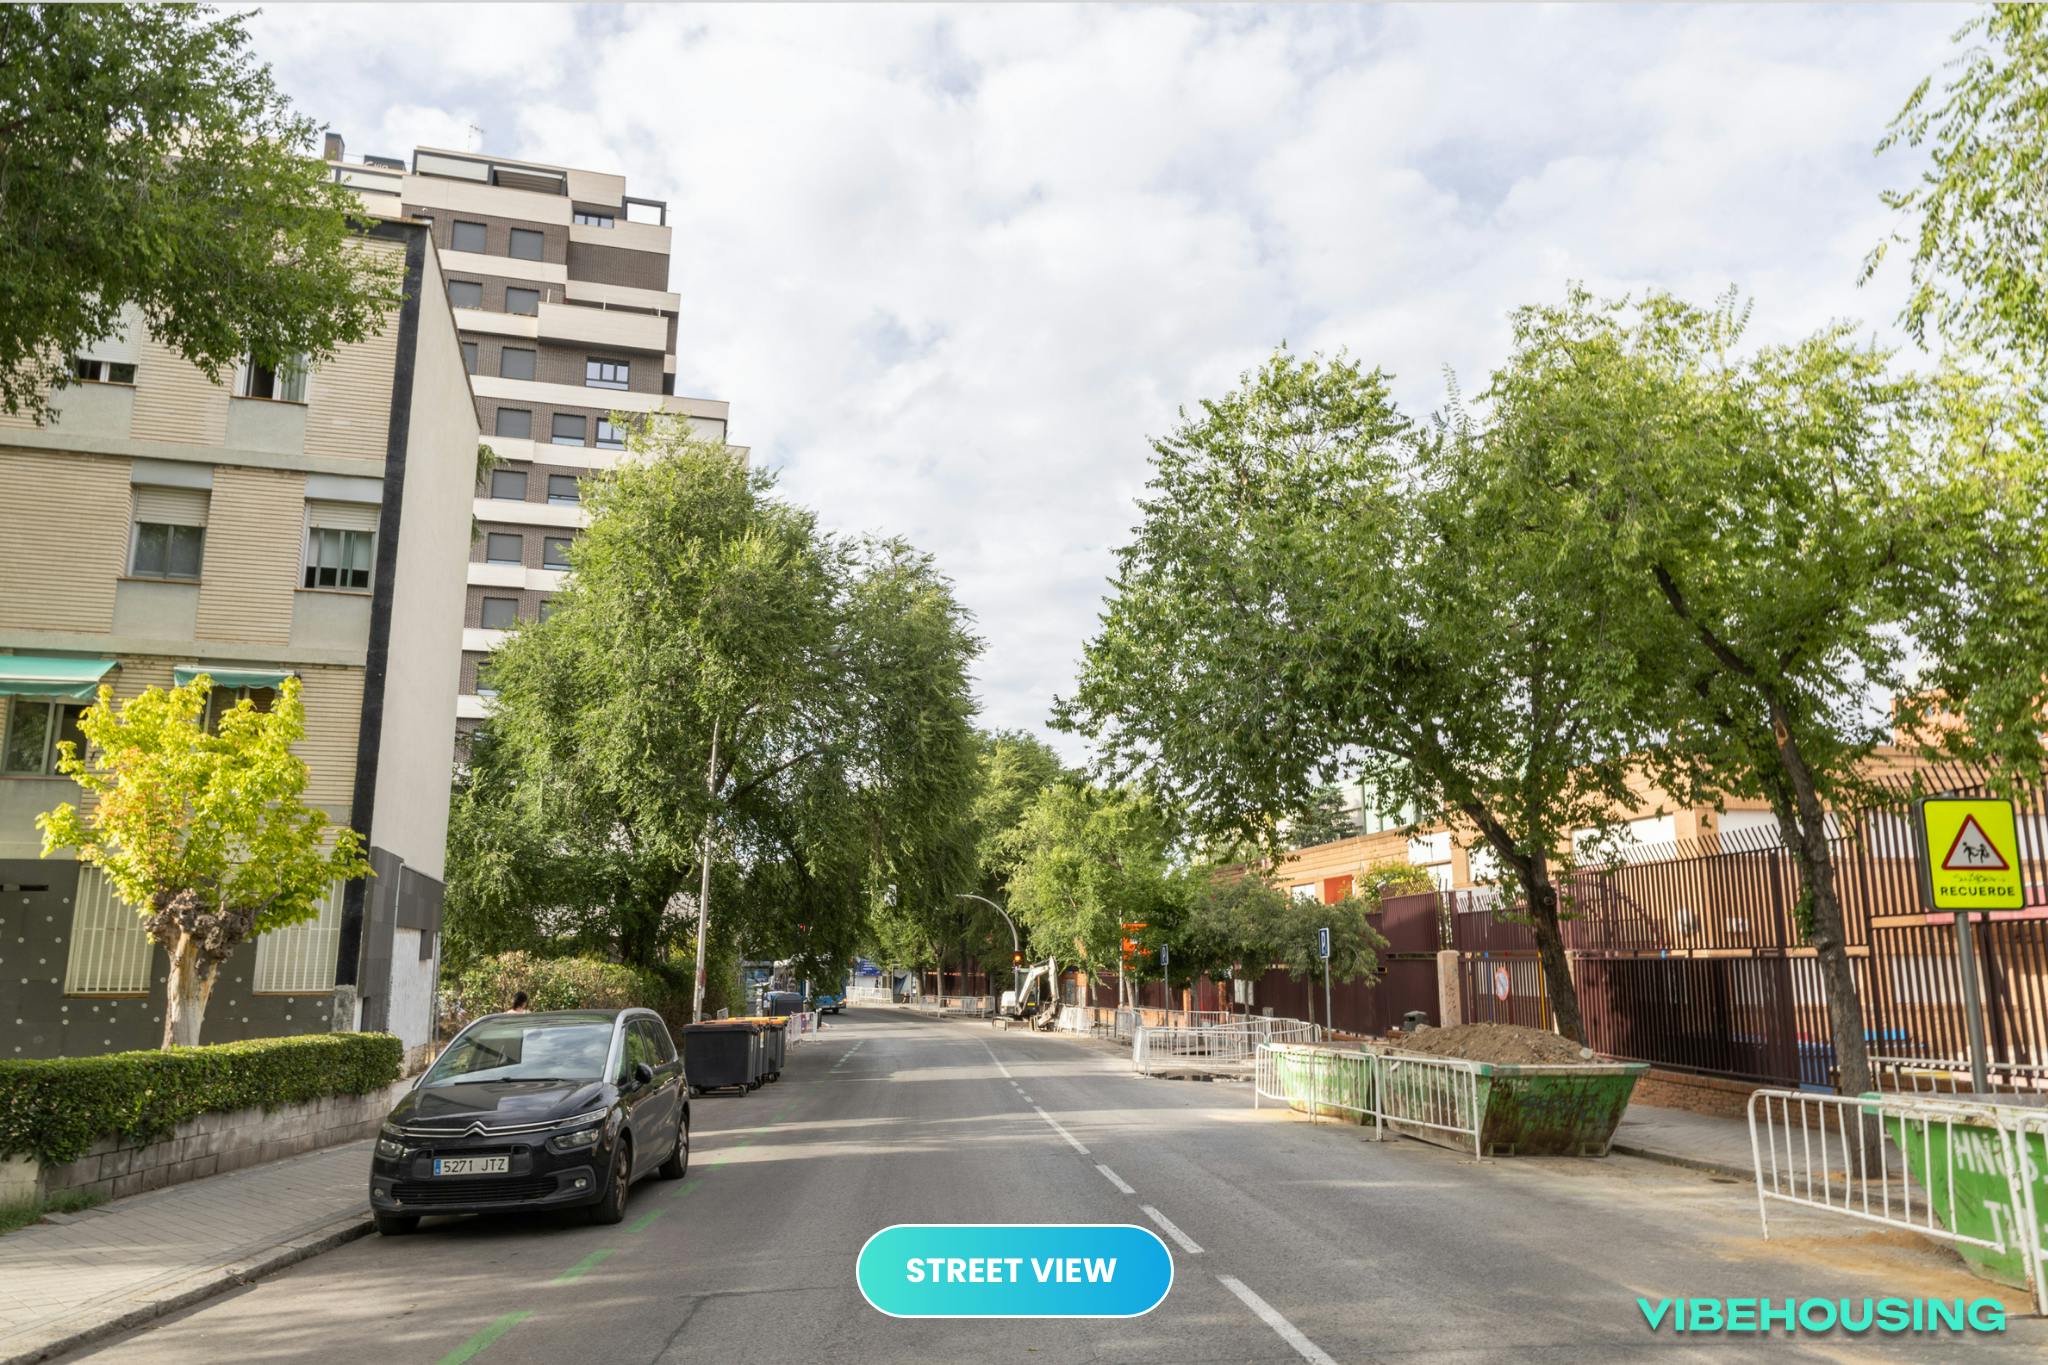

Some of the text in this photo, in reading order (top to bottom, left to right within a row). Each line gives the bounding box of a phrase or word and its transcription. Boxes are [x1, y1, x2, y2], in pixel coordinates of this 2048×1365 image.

[1940, 886, 2015, 897] RECUERDE
[444, 1158, 506, 1173] 5271 JTZ
